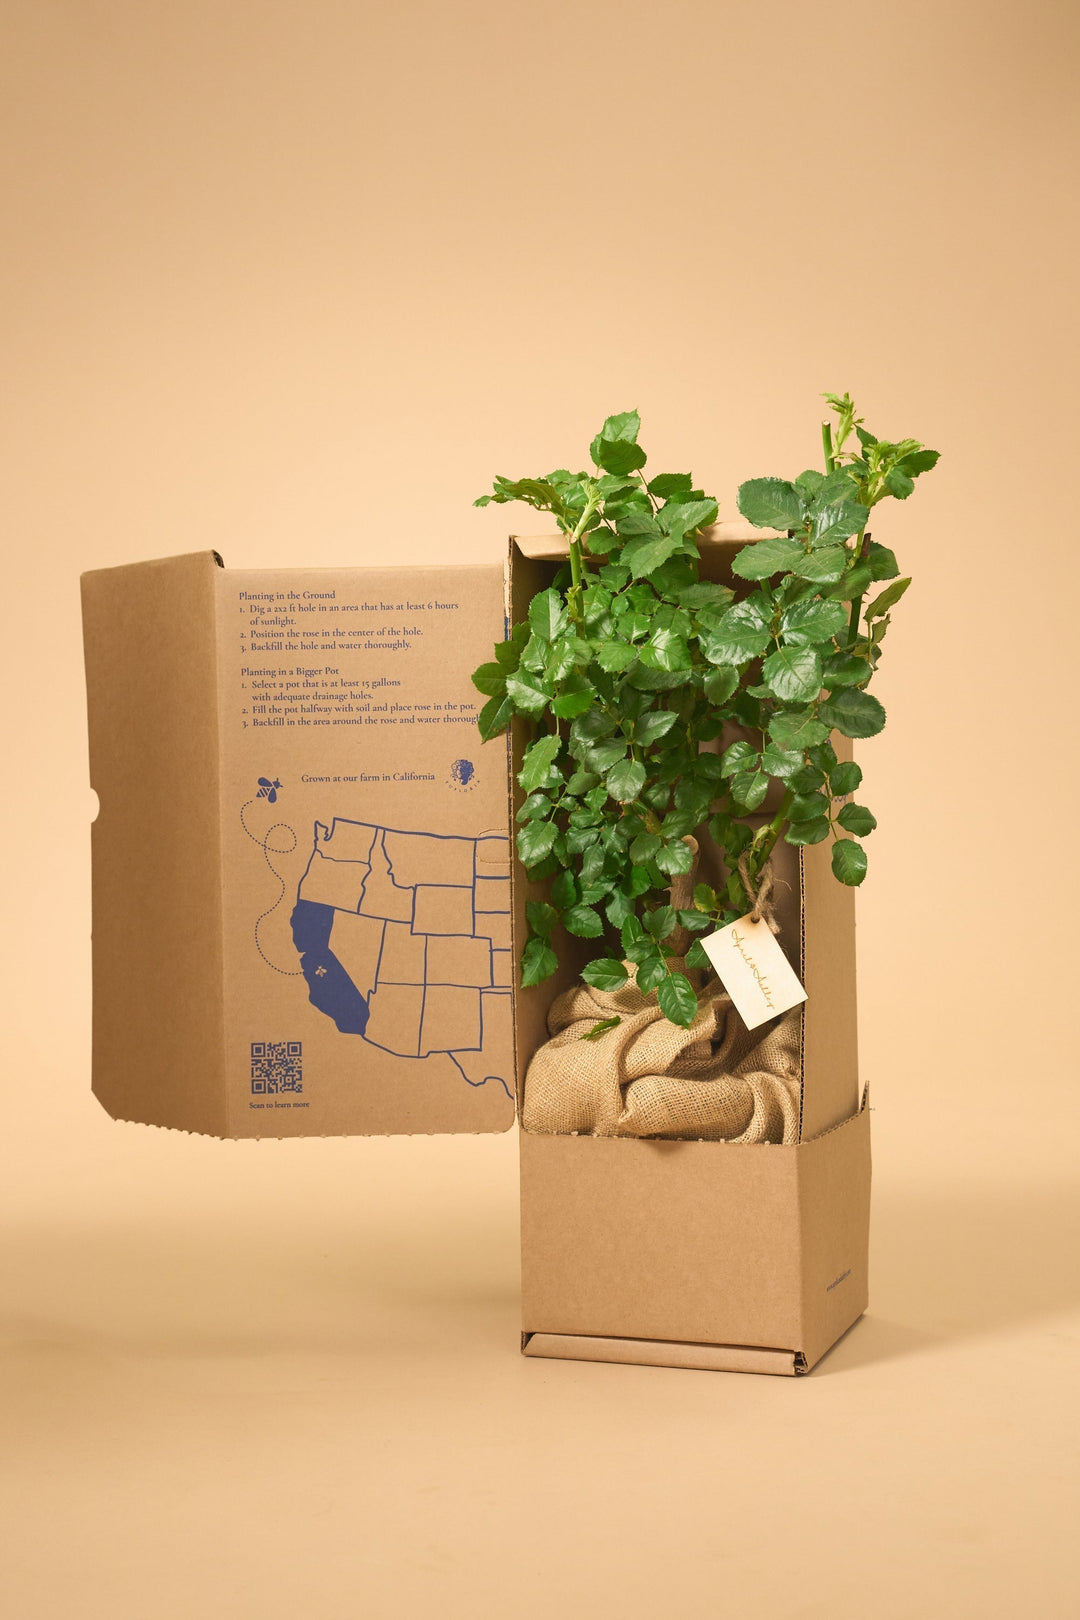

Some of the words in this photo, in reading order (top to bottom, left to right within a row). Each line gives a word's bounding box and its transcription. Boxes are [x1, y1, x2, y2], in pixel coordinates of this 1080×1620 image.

[239, 591, 275, 603] Planting
[276, 592, 285, 600] in
[287, 590, 301, 600] the
[302, 590, 336, 599] Ground
[250, 604, 266, 616] Dig
[289, 603, 296, 612] ft
[298, 603, 316, 612] hole
[318, 604, 327, 612] in
[361, 602, 378, 611] that
[380, 602, 394, 611] has
[406, 601, 425, 610] least
[435, 600, 459, 610] hours
[250, 616, 260, 625] of
[261, 616, 297, 628] sunlight.
[251, 629, 284, 638] Position
[287, 628, 300, 638] the
[332, 628, 346, 637] the
[376, 627, 387, 636] of
[387, 627, 401, 636] the
[403, 626, 424, 636] hole.
[251, 641, 283, 651] Backfill
[285, 641, 299, 650] the
[300, 641, 319, 650] hole
[320, 640, 336, 650] and
[364, 639, 412, 651] thoroughly.
[241, 667, 277, 679] Planting
[278, 668, 287, 676] in
[296, 667, 323, 678] Bigger
[325, 666, 339, 675] Pot
[252, 679, 276, 689] Select
[286, 682, 300, 691] pot
[302, 679, 319, 688] that
[340, 678, 359, 687] least
[362, 681, 370, 689] 15
[372, 677, 401, 689] gallons
[252, 692, 271, 701] with
[273, 691, 311, 704] adequate
[312, 691, 348, 703] drainage
[350, 690, 374, 699] holes.
[253, 705, 266, 714] Fill
[269, 704, 282, 713] the
[284, 707, 298, 716] pot
[301, 703, 333, 715] halfway
[334, 703, 354, 712] with
[356, 703, 370, 712] soil
[372, 702, 388, 712] and
[390, 702, 412, 714] place
[444, 701, 458, 710] the
[460, 704, 476, 713] pot.
[253, 717, 285, 726] Backfill
[298, 716, 311, 726] the
[332, 716, 363, 725] around
[364, 715, 378, 724] the
[400, 714, 415, 724] and
[301, 774, 331, 783] Grown
[360, 772, 380, 782] farm
[392, 771, 435, 781] California
